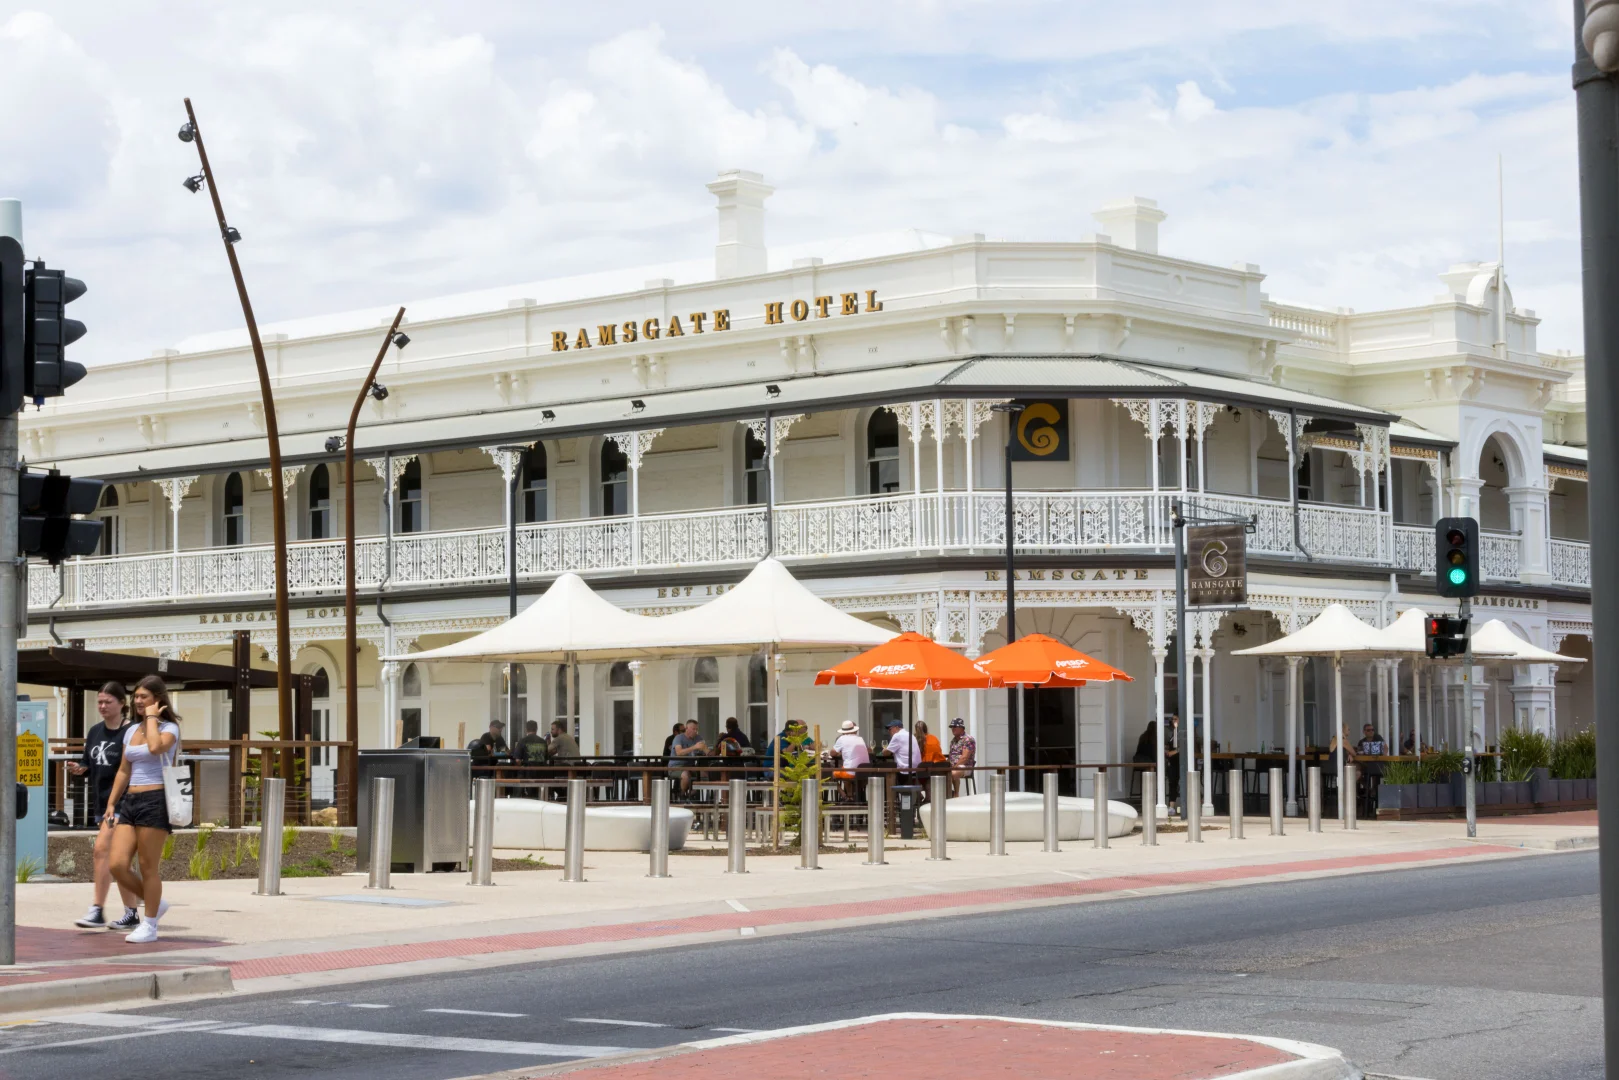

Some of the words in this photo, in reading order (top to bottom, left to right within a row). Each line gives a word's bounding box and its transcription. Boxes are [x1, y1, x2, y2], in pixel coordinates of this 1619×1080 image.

[551, 309, 730, 351] RAMSGATE
[764, 290, 883, 325] HOTEL
[985, 569, 1149, 581] RAMSGATE
[1191, 580, 1243, 589] RAMSGATE
[657, 587, 693, 599] EST
[1473, 596, 1539, 609] RAMSGATE
[199, 611, 277, 624] RAMSGAT
[869, 663, 916, 674] APEROL
[1055, 659, 1091, 668] APEROL
[23, 749, 38, 757] 1800
[19, 759, 30, 767] 018
[31, 759, 41, 767] 313
[19, 774, 28, 782] PC
[29, 774, 41, 782] 255
